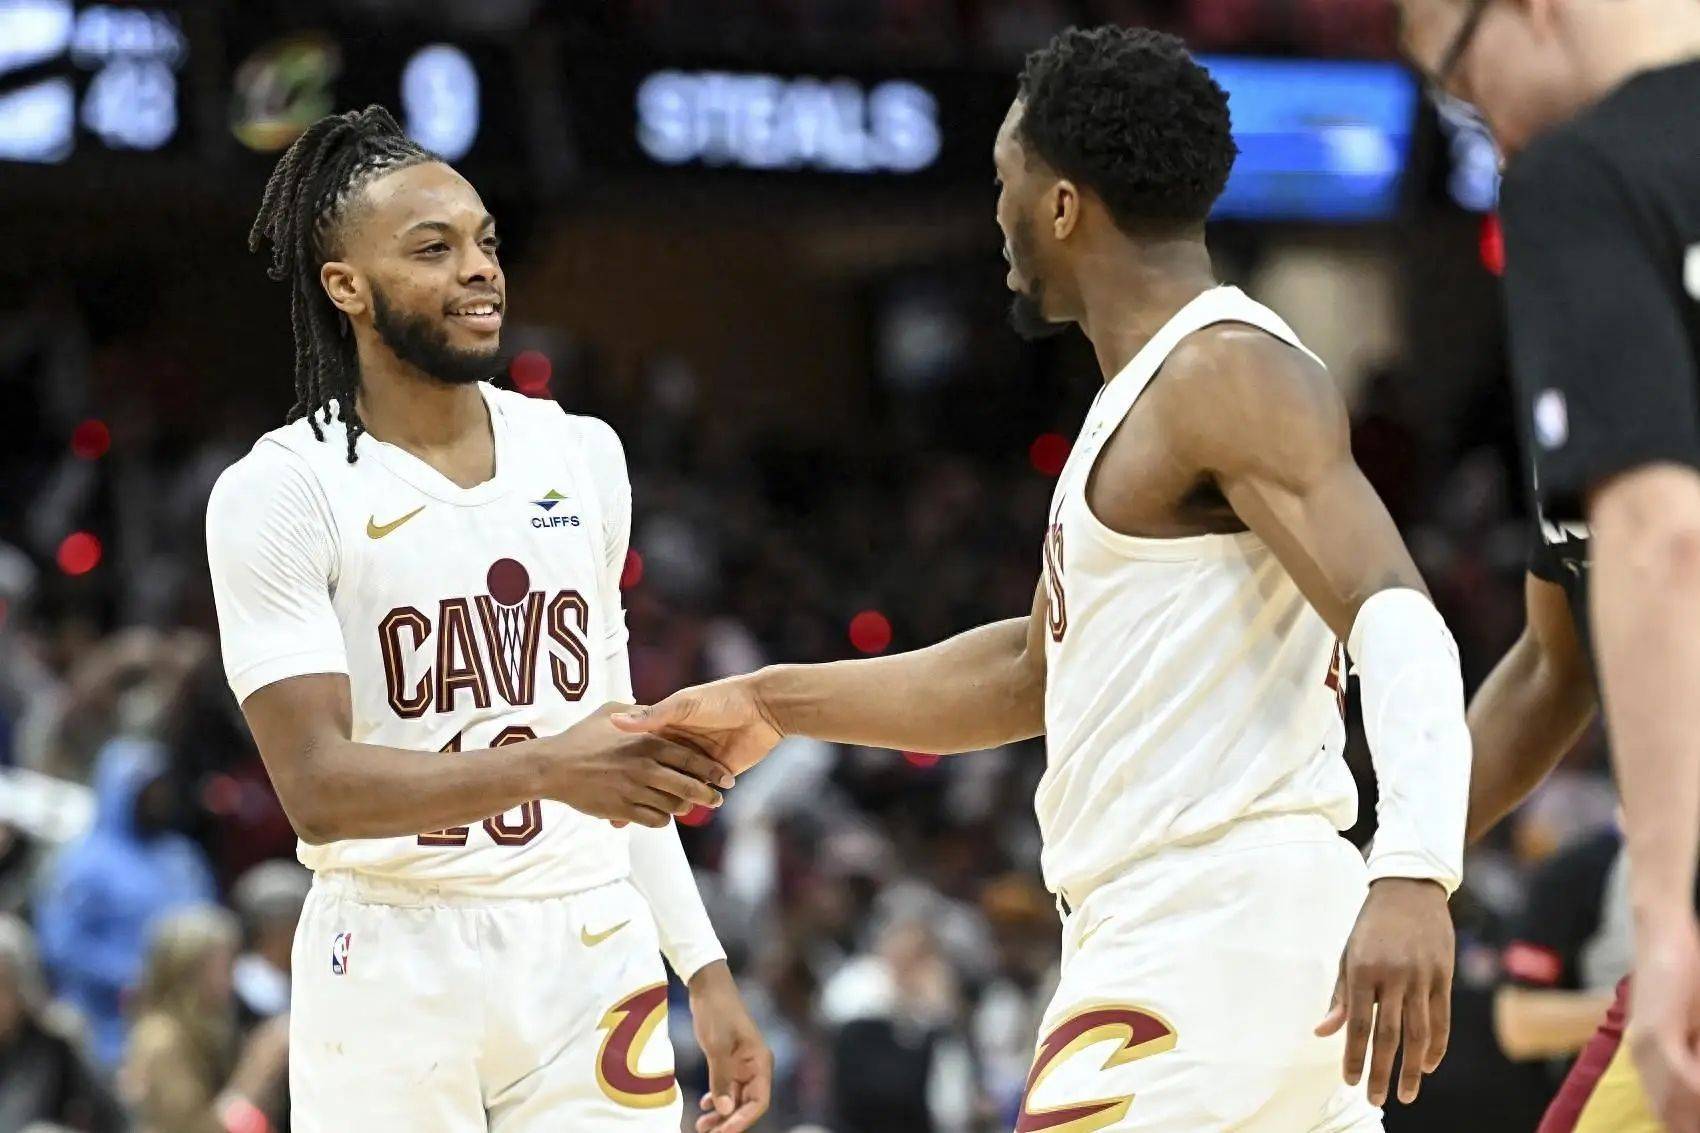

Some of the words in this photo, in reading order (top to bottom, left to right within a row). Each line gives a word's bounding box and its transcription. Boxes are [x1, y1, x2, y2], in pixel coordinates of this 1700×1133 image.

[637, 71, 941, 172] STEALS
[531, 515, 580, 529] CLIFFS
[378, 589, 589, 719] CAVS
